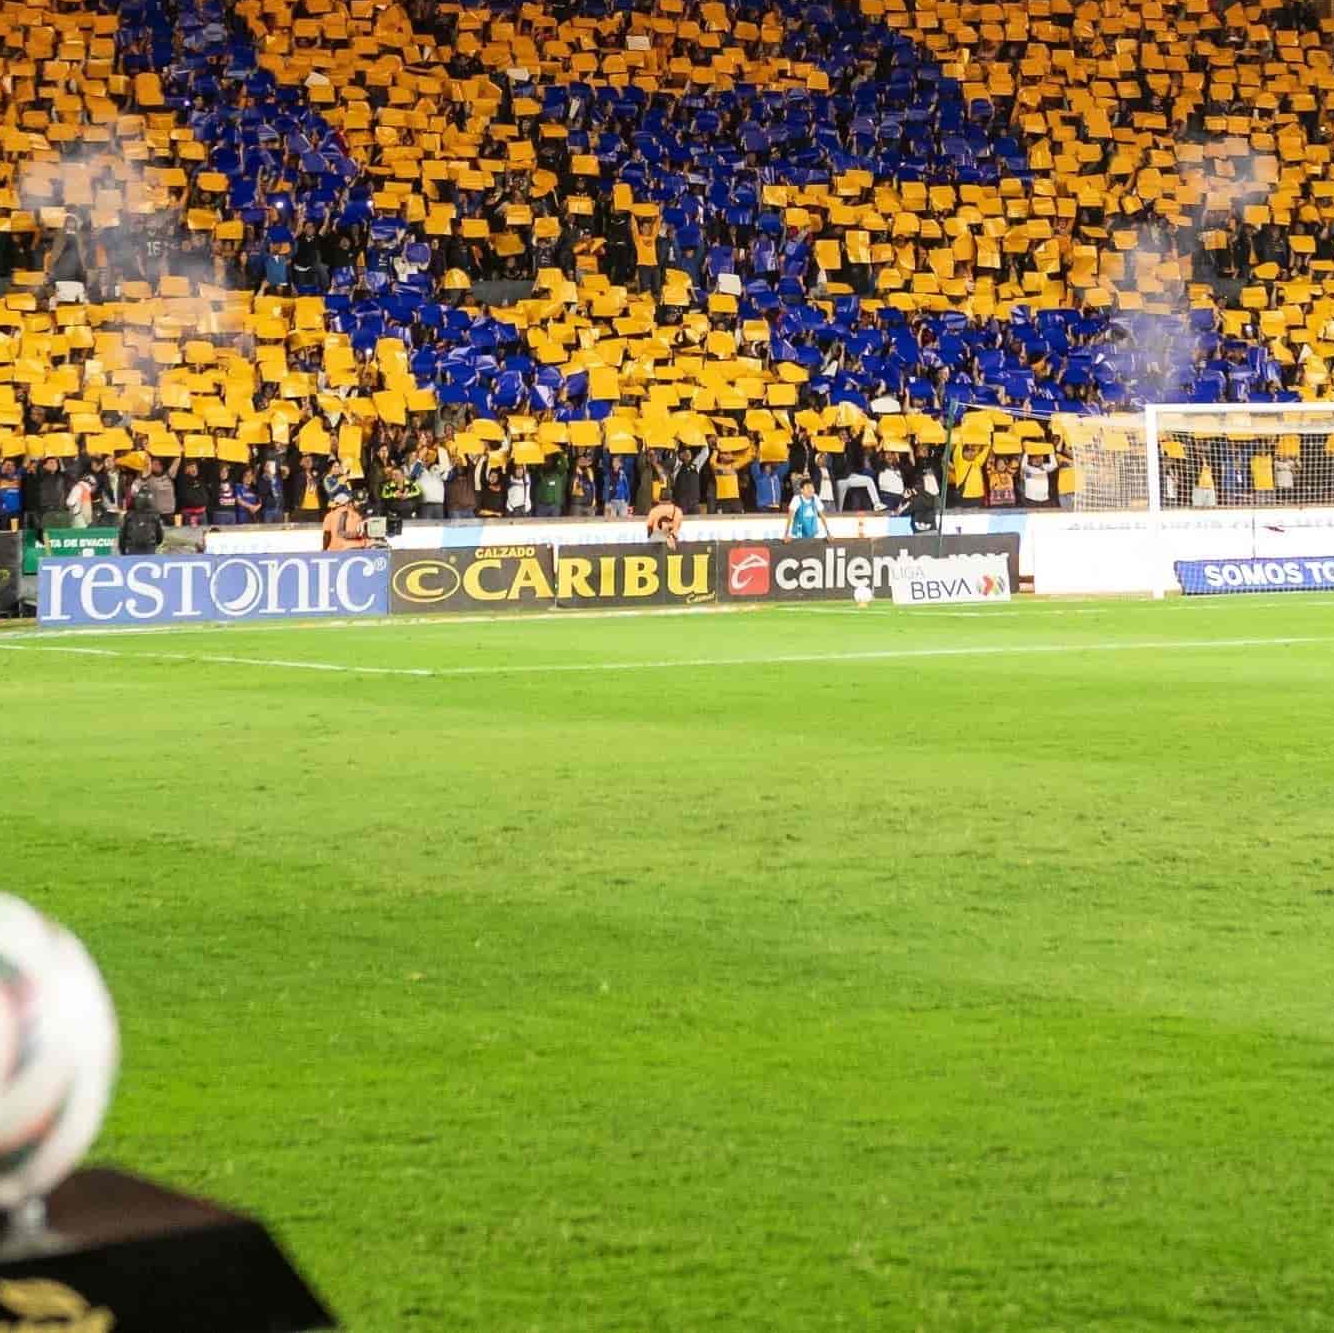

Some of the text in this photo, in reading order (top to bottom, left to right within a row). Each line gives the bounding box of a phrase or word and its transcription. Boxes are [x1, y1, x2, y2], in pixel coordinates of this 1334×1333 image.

[475, 546, 535, 558] CALZADO
[462, 553, 709, 601] CARIBU
[1203, 562, 1302, 587] SOMOS
[911, 578, 972, 601] BBVA
